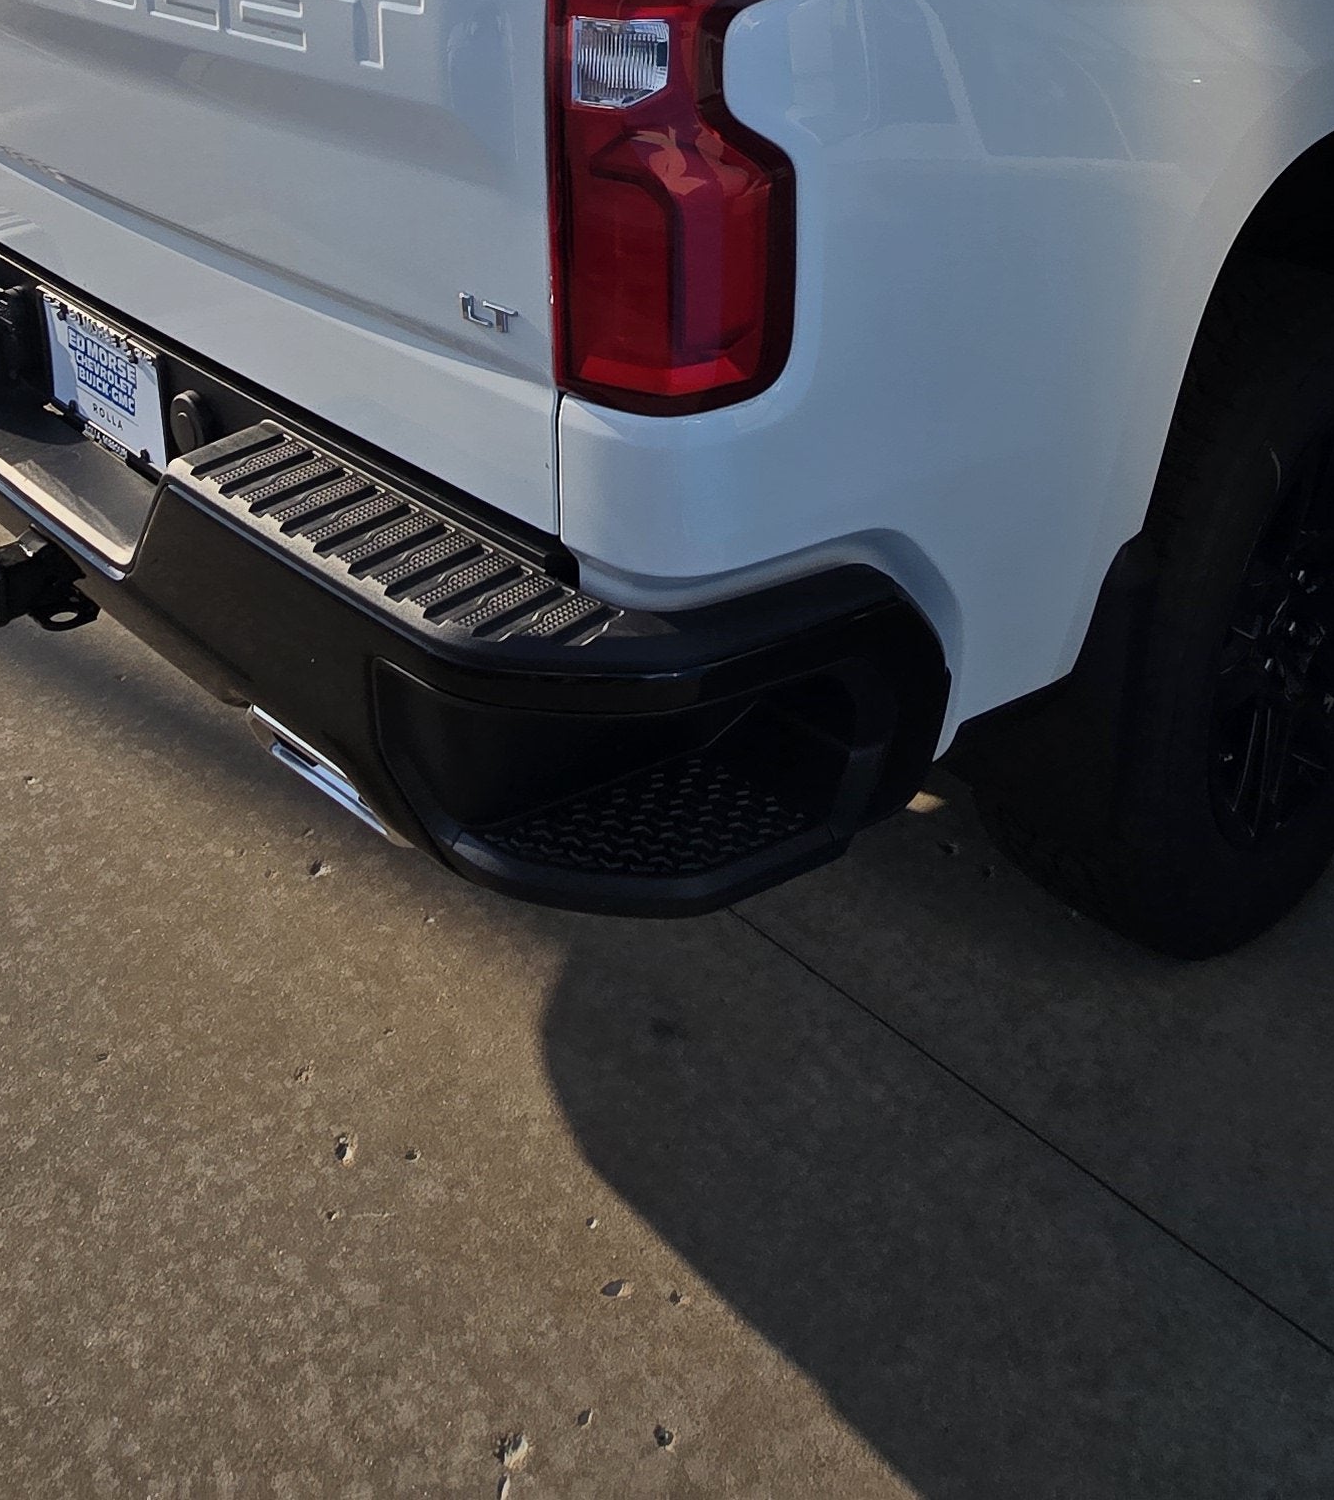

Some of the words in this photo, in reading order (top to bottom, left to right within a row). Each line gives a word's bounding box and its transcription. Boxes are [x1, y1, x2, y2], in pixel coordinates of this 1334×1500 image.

[459, 292, 518, 333] LT
[68, 327, 85, 352] ED
[87, 338, 136, 383] MORSE
[93, 403, 123, 430] ROLLA
